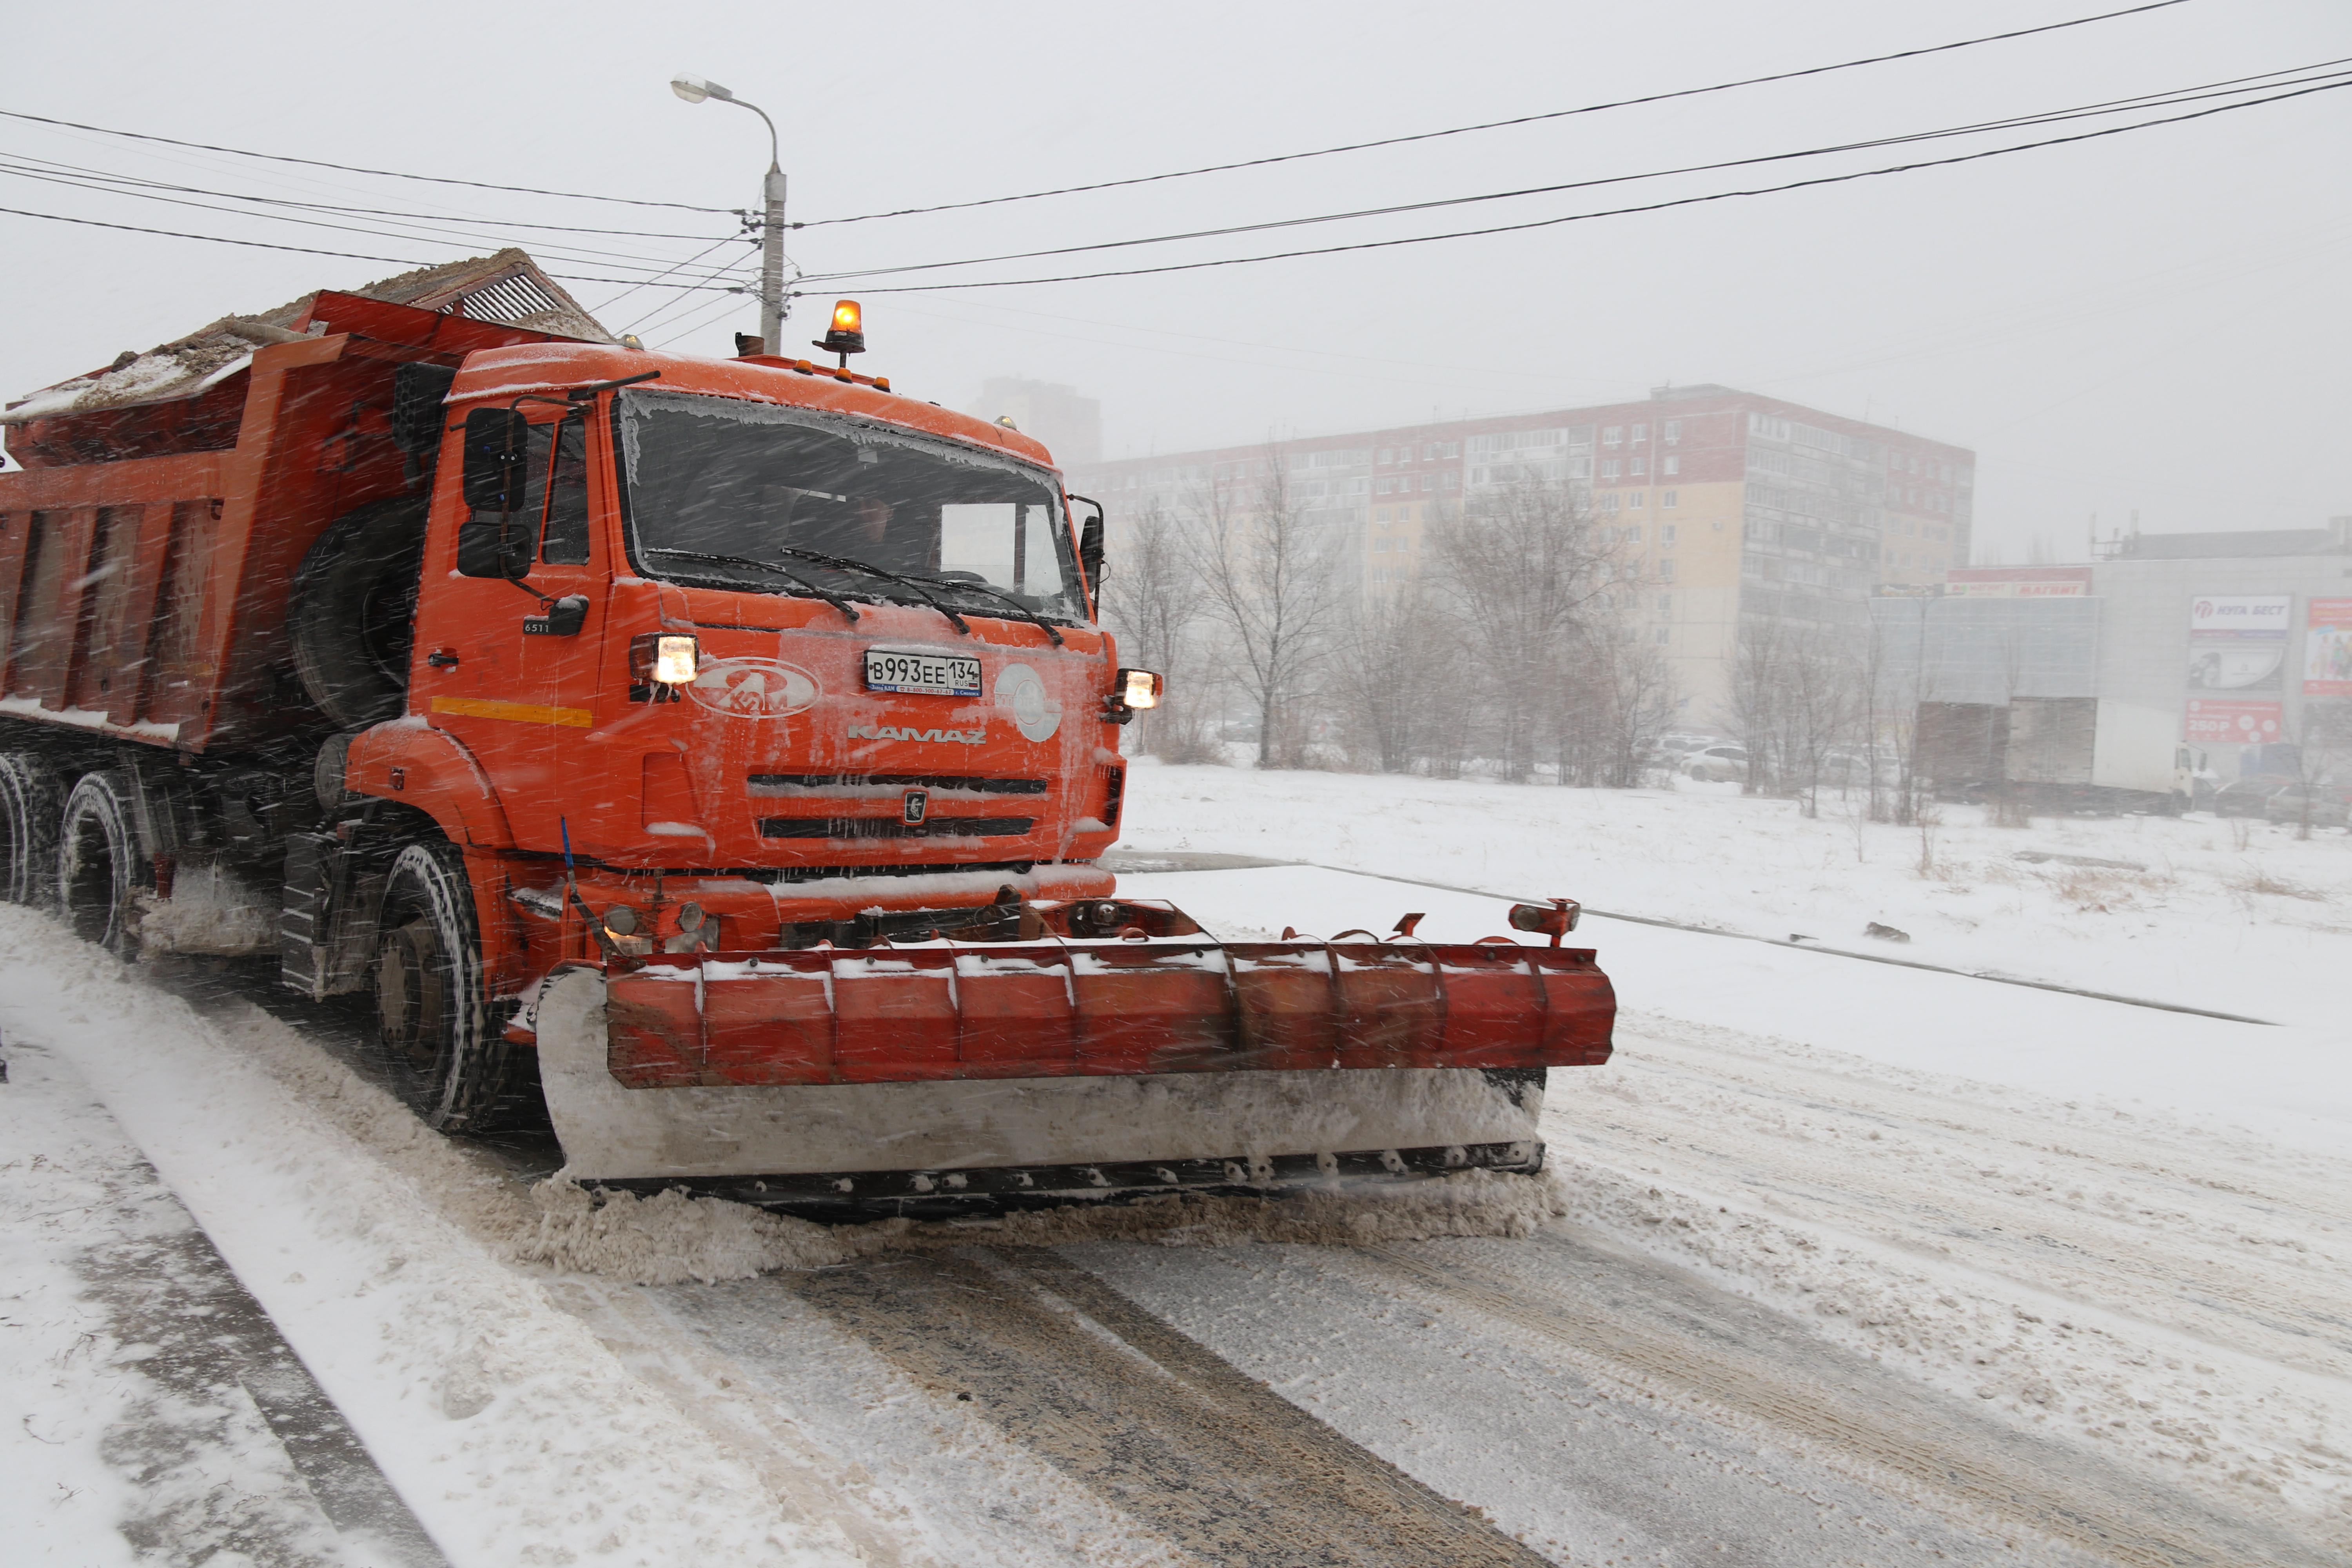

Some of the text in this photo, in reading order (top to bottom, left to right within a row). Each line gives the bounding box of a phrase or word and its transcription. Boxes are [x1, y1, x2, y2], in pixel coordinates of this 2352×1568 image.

[2019, 586, 2079, 595] МАГНИТ
[2217, 606, 2285, 615] НУГА БЕСТ
[525, 624, 548, 632] 6511
[949, 661, 975, 680] 134
[2188, 719, 2218, 732] 250
[848, 724, 987, 744] KAMAZ
